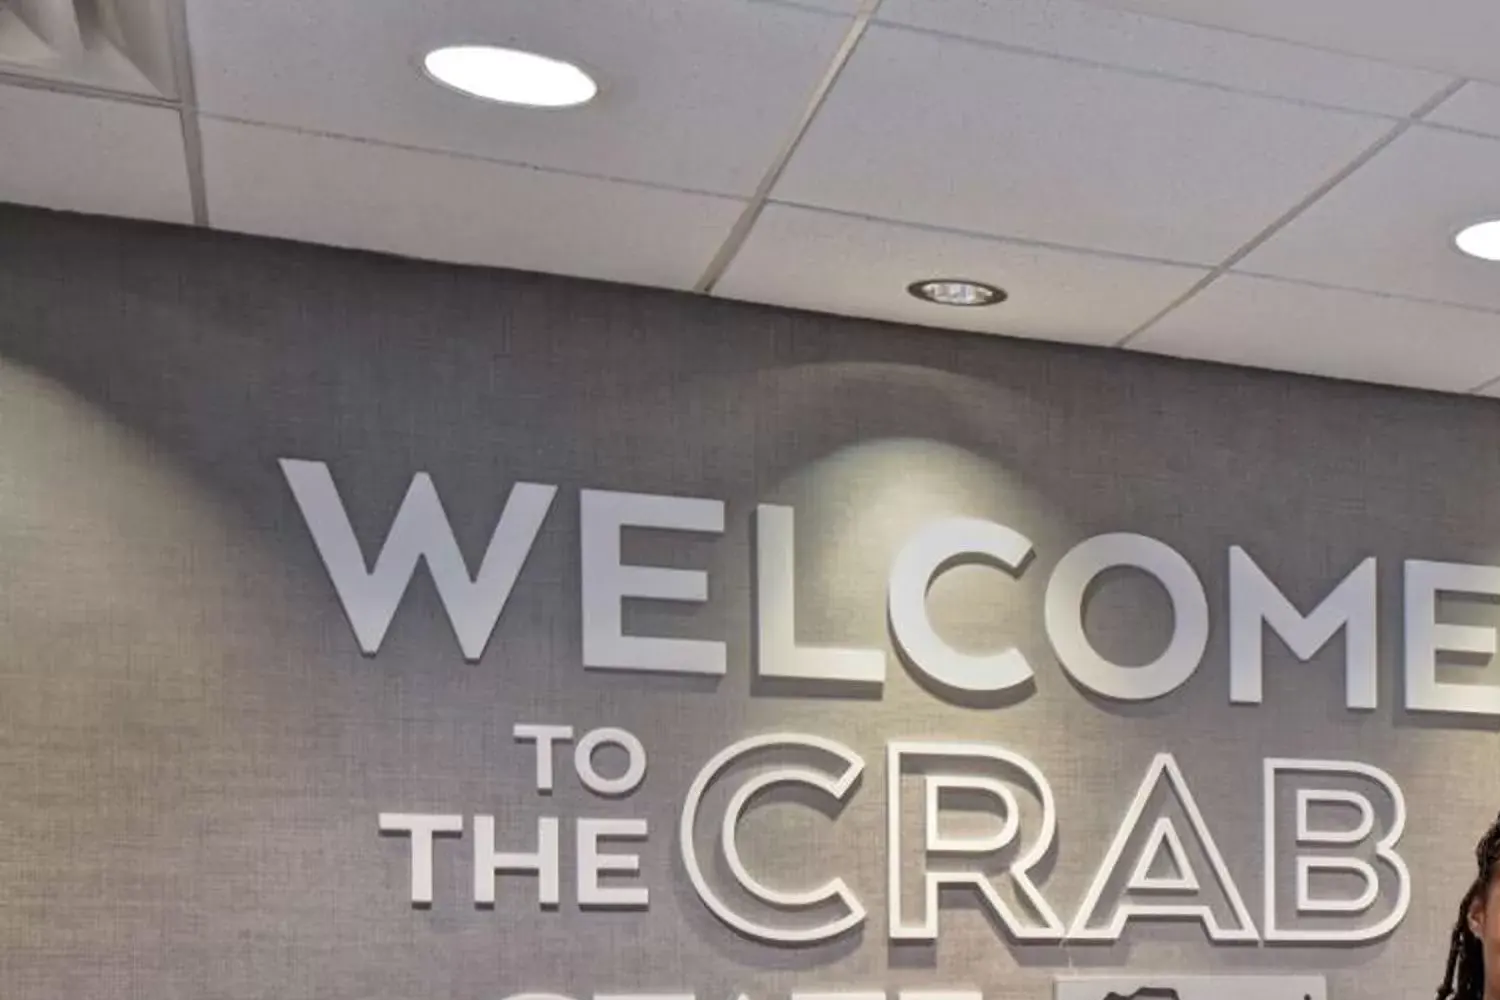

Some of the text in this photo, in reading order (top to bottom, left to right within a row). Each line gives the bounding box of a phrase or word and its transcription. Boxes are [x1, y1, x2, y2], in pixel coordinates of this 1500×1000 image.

[513, 724, 647, 796] TO
[378, 732, 1411, 946] THE CRAB
